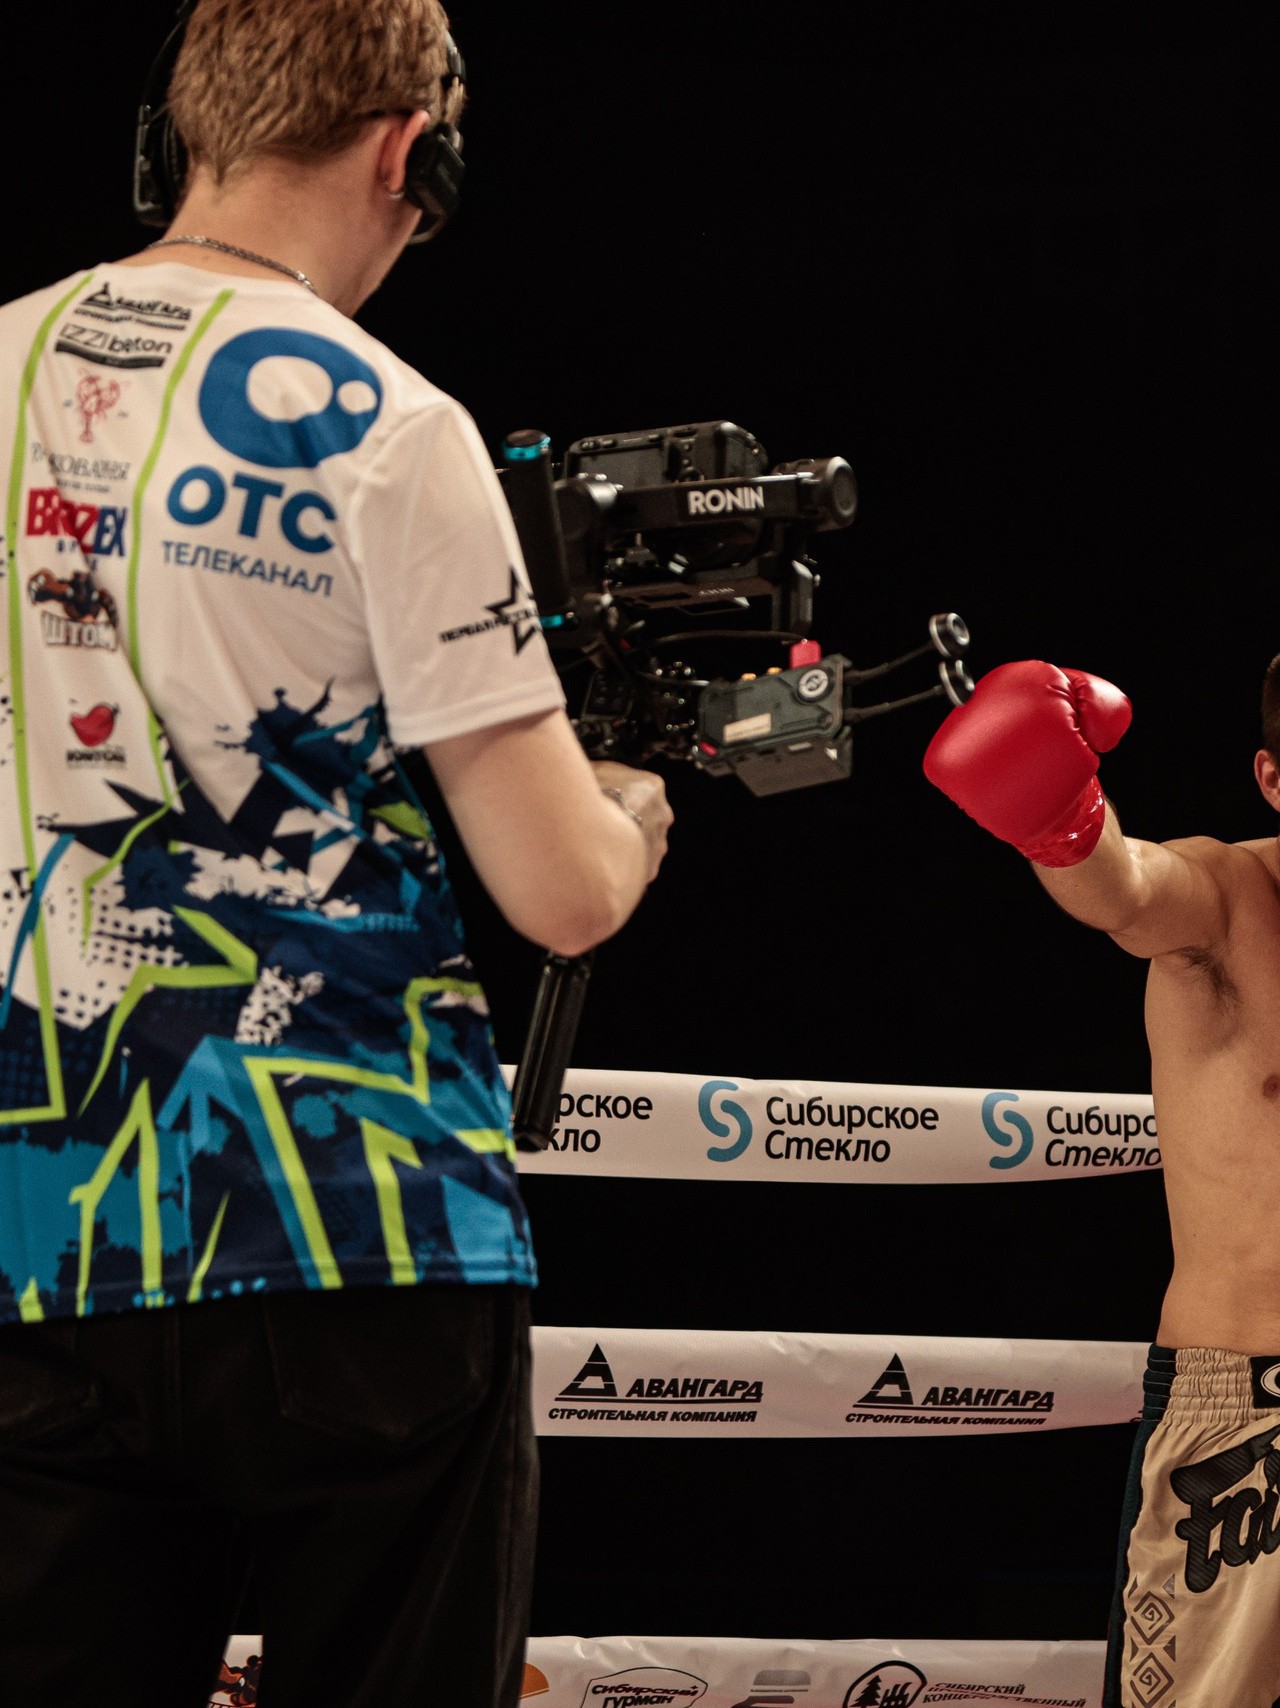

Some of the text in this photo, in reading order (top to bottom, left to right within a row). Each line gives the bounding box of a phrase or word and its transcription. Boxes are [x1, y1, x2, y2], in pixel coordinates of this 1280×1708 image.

[687, 485, 764, 515] RONIN
[161, 540, 333, 598] ТЕЛЕКАНАЛ
[766, 1096, 940, 1134] Сибирское
[765, 1129, 891, 1162] Стекло
[1045, 1139, 1162, 1167] Стекло
[626, 1378, 764, 1400] АВАНГАРД
[921, 1386, 1055, 1411] АВАНГАРД
[548, 1407, 759, 1423] СТРОИТЕЛЬНАЯ КОМПАНИЯ
[845, 1412, 1047, 1426] СТРОИТЕЛЬНАЯ КОМПАНИЯ
[935, 1682, 1026, 1695] СИБИРСКИЙ
